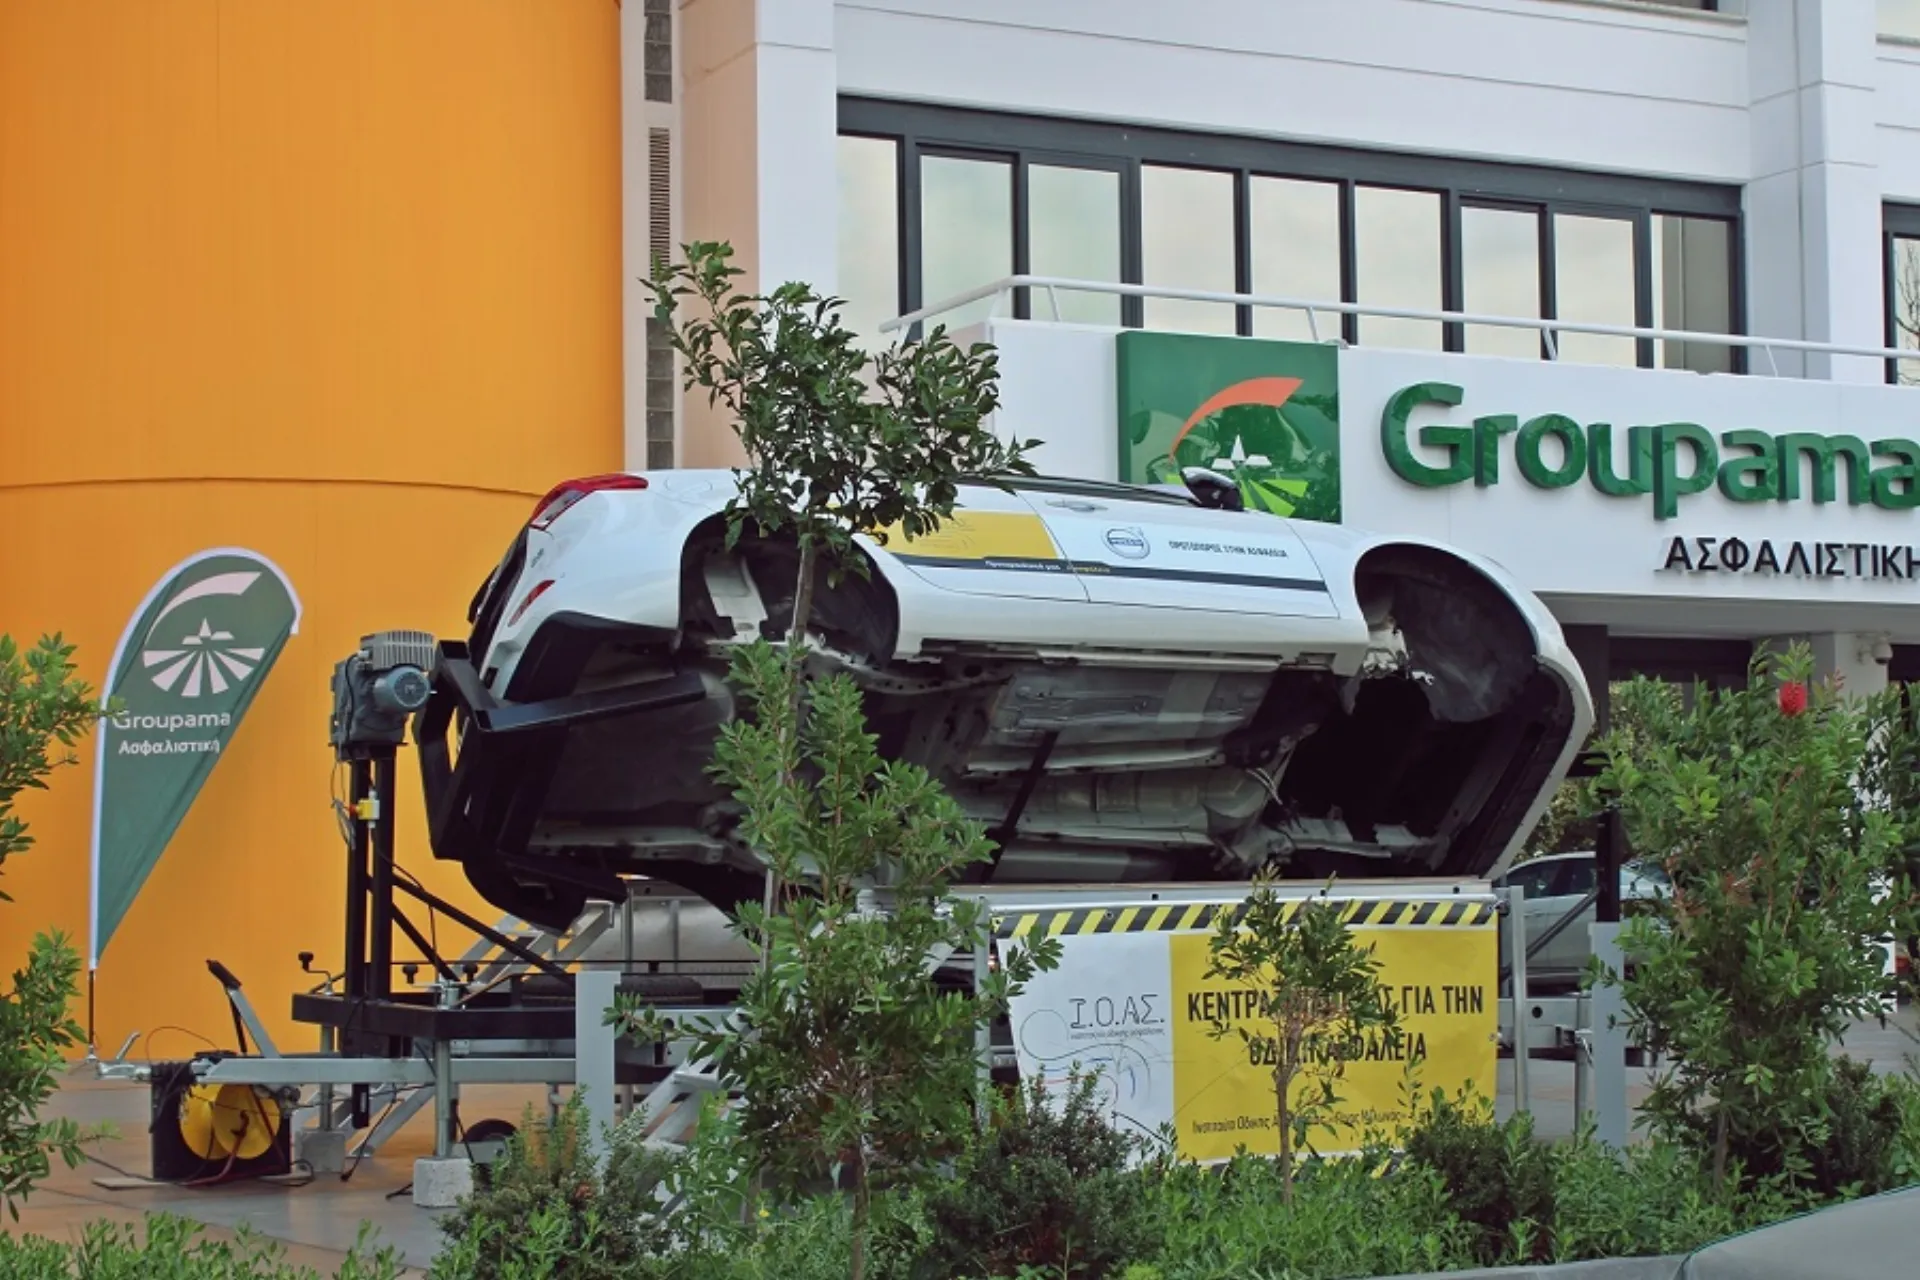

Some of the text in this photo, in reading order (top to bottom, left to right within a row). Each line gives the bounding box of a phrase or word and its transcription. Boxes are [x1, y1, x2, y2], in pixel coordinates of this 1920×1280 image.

[1381, 381, 1920, 520] Groupama
[112, 709, 231, 732] Groupama
[1402, 986, 1436, 1014] ΓΙΑ
[1442, 986, 1483, 1013] ΤΗΝ
